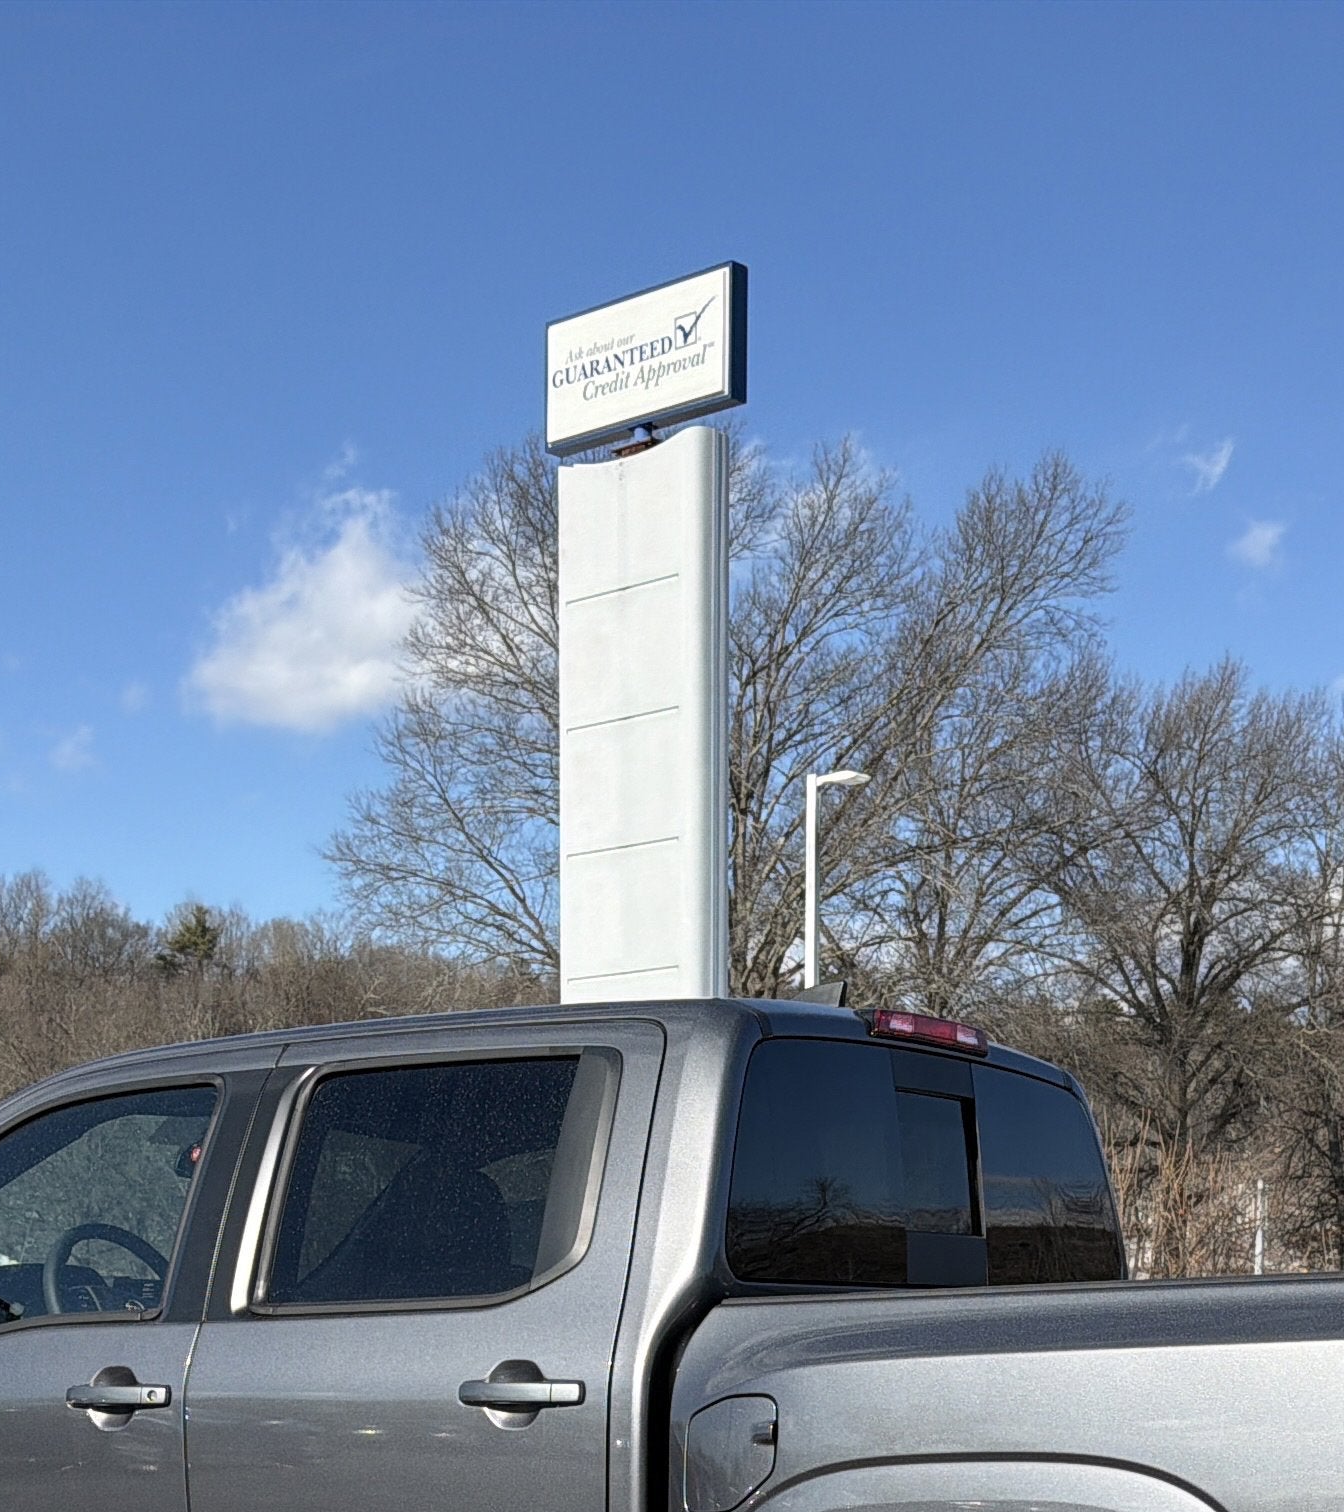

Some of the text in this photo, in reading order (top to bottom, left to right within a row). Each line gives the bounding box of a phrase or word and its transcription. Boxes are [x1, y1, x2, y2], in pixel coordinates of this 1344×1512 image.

[552, 335, 673, 389] GUARANTEED
[565, 334, 635, 365] Ask about our
[582, 343, 708, 401] Credit Approval
